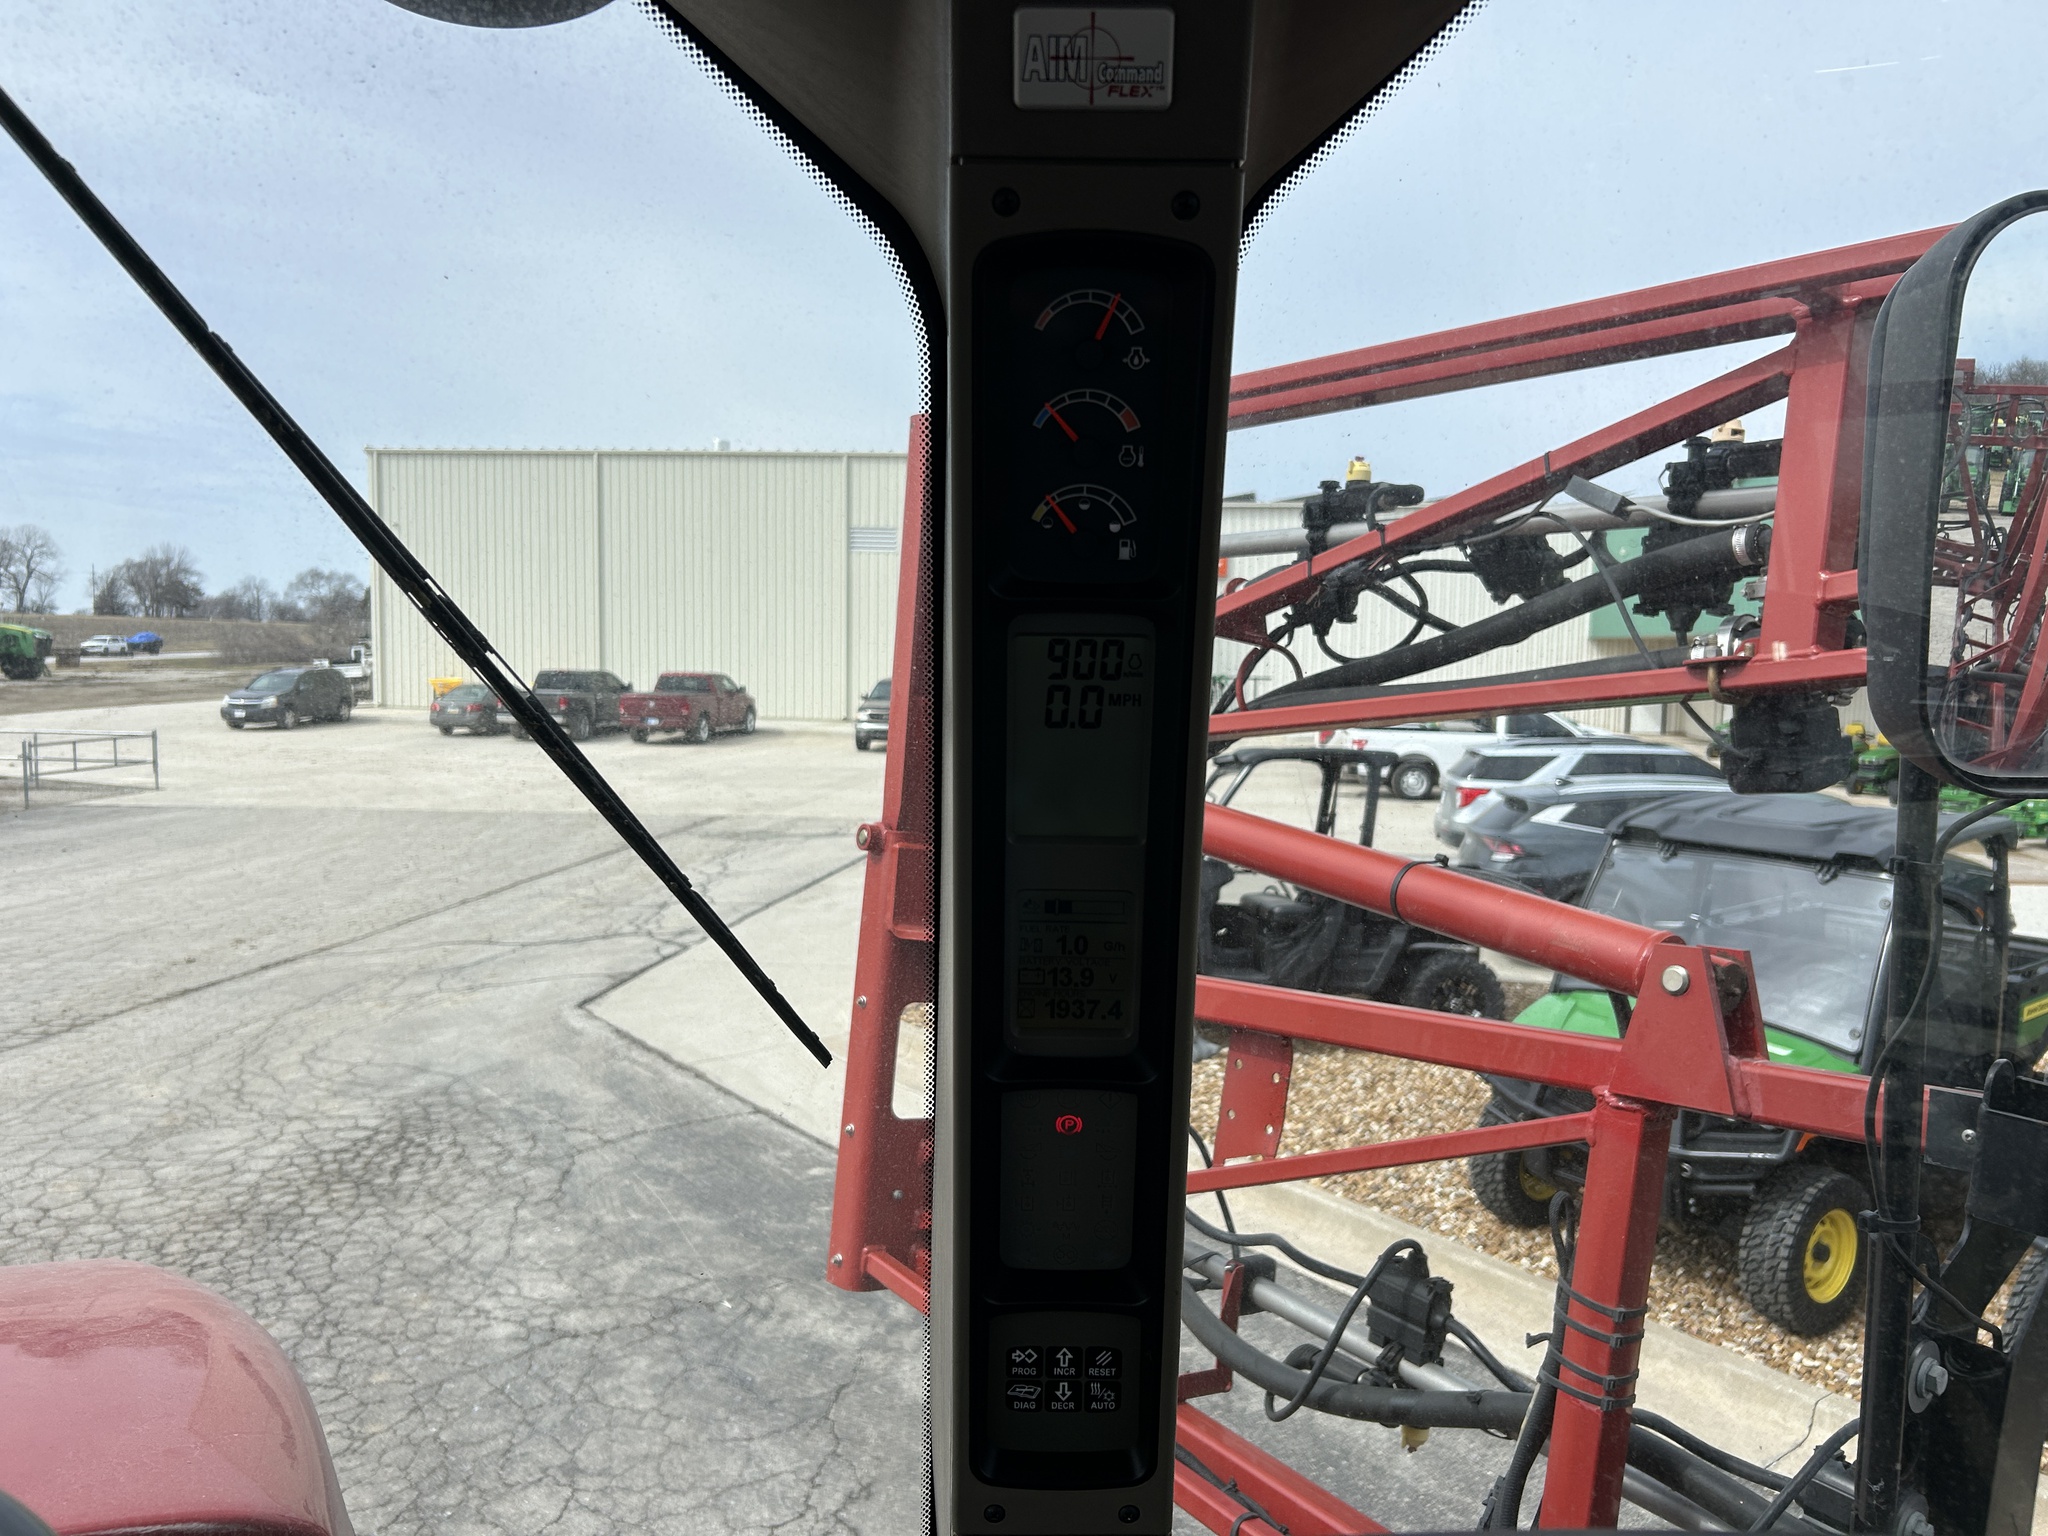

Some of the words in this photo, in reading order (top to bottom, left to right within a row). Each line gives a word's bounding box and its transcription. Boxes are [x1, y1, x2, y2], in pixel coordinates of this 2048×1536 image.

[1022, 34, 1088, 83] AIM
[1097, 60, 1164, 84] Command
[1048, 638, 1125, 681] 900
[1044, 684, 1105, 729] 0.0
[1108, 693, 1142, 707] MPH
[1056, 934, 1089, 955] 1.0
[1047, 966, 1095, 988] 13.9
[1044, 998, 1123, 1020] 1937.4
[1012, 1367, 1037, 1376] PROG
[1054, 1367, 1076, 1376] INCR
[1088, 1367, 1117, 1376] RESET
[1013, 1401, 1036, 1410] DIAG
[1051, 1401, 1075, 1410] DECR
[1090, 1401, 1116, 1410] AUTO
